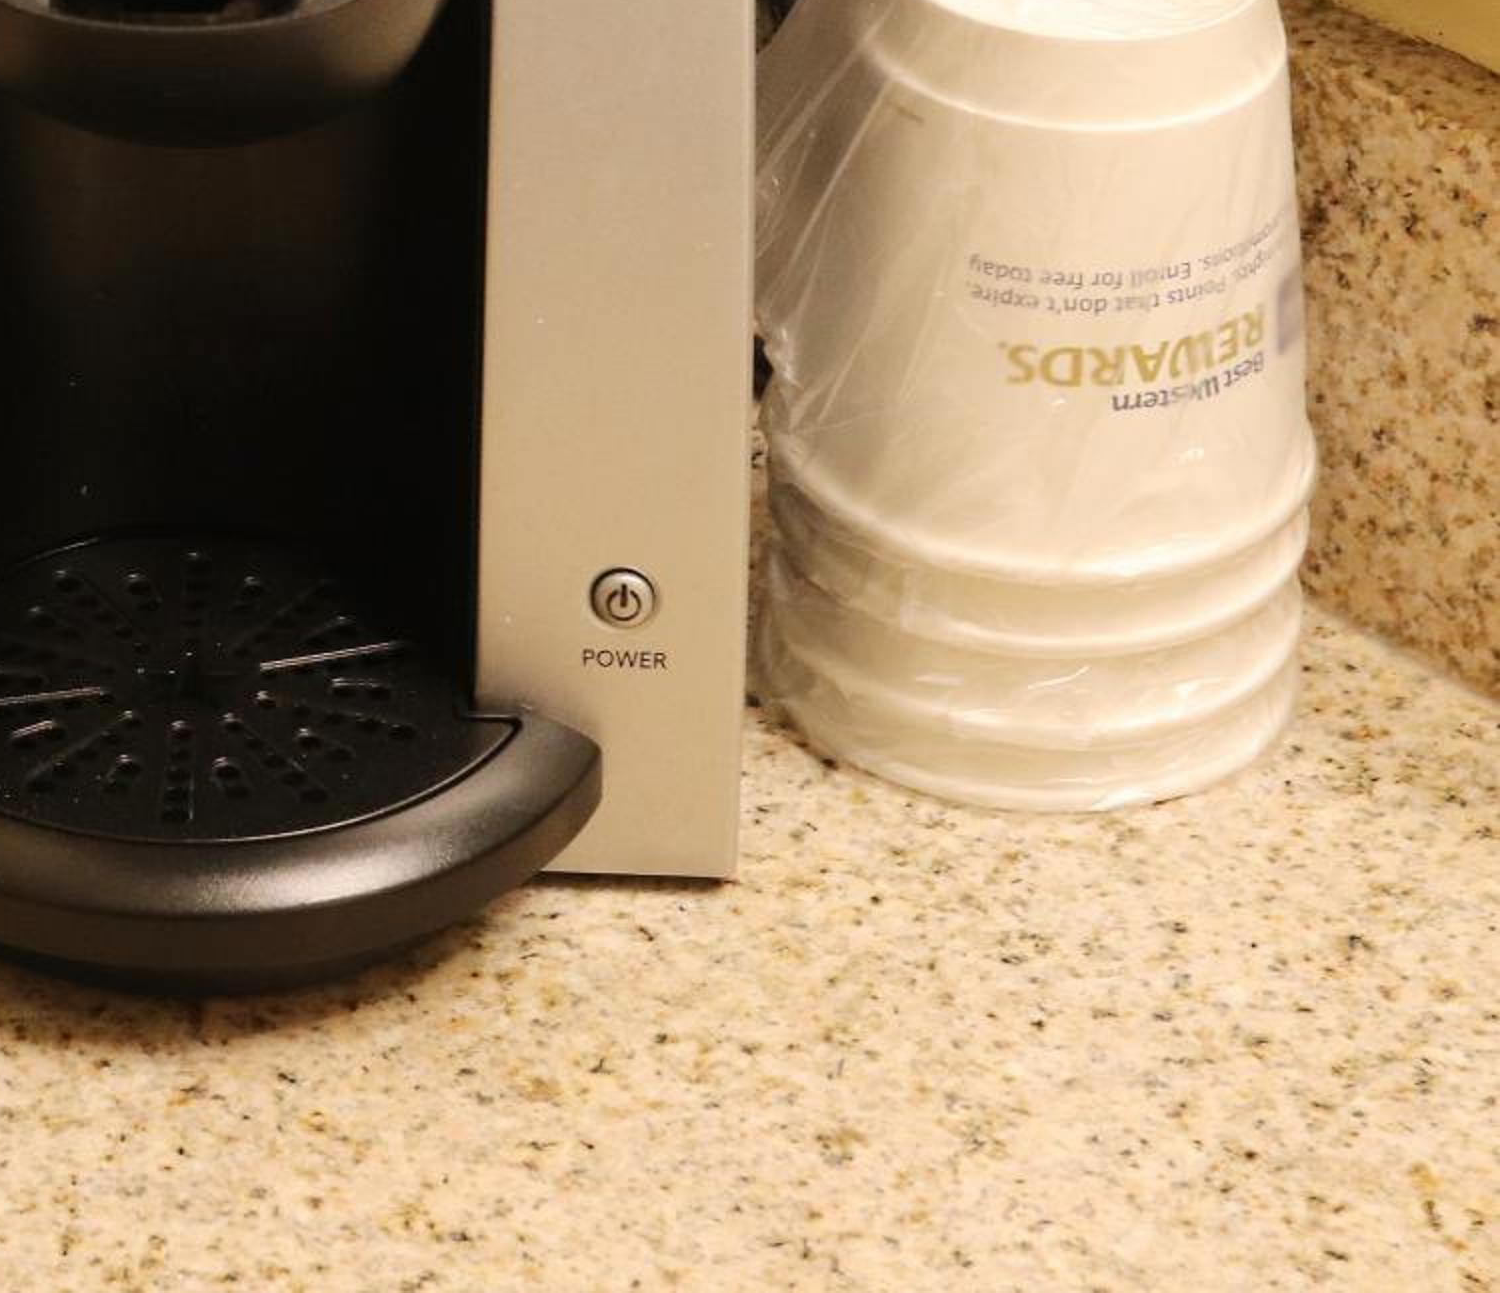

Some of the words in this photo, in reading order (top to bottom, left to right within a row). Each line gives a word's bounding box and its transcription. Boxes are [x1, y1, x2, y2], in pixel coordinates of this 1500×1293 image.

[969, 254, 1032, 283] today
[1040, 270, 1083, 289] free
[1092, 271, 1124, 290] for
[966, 280, 1040, 307] expire.
[1167, 275, 1227, 305] Points
[1046, 296, 1108, 315] don't
[1223, 350, 1265, 387] Best
[1111, 378, 1220, 412] Western
[581, 648, 668, 670] POWER
